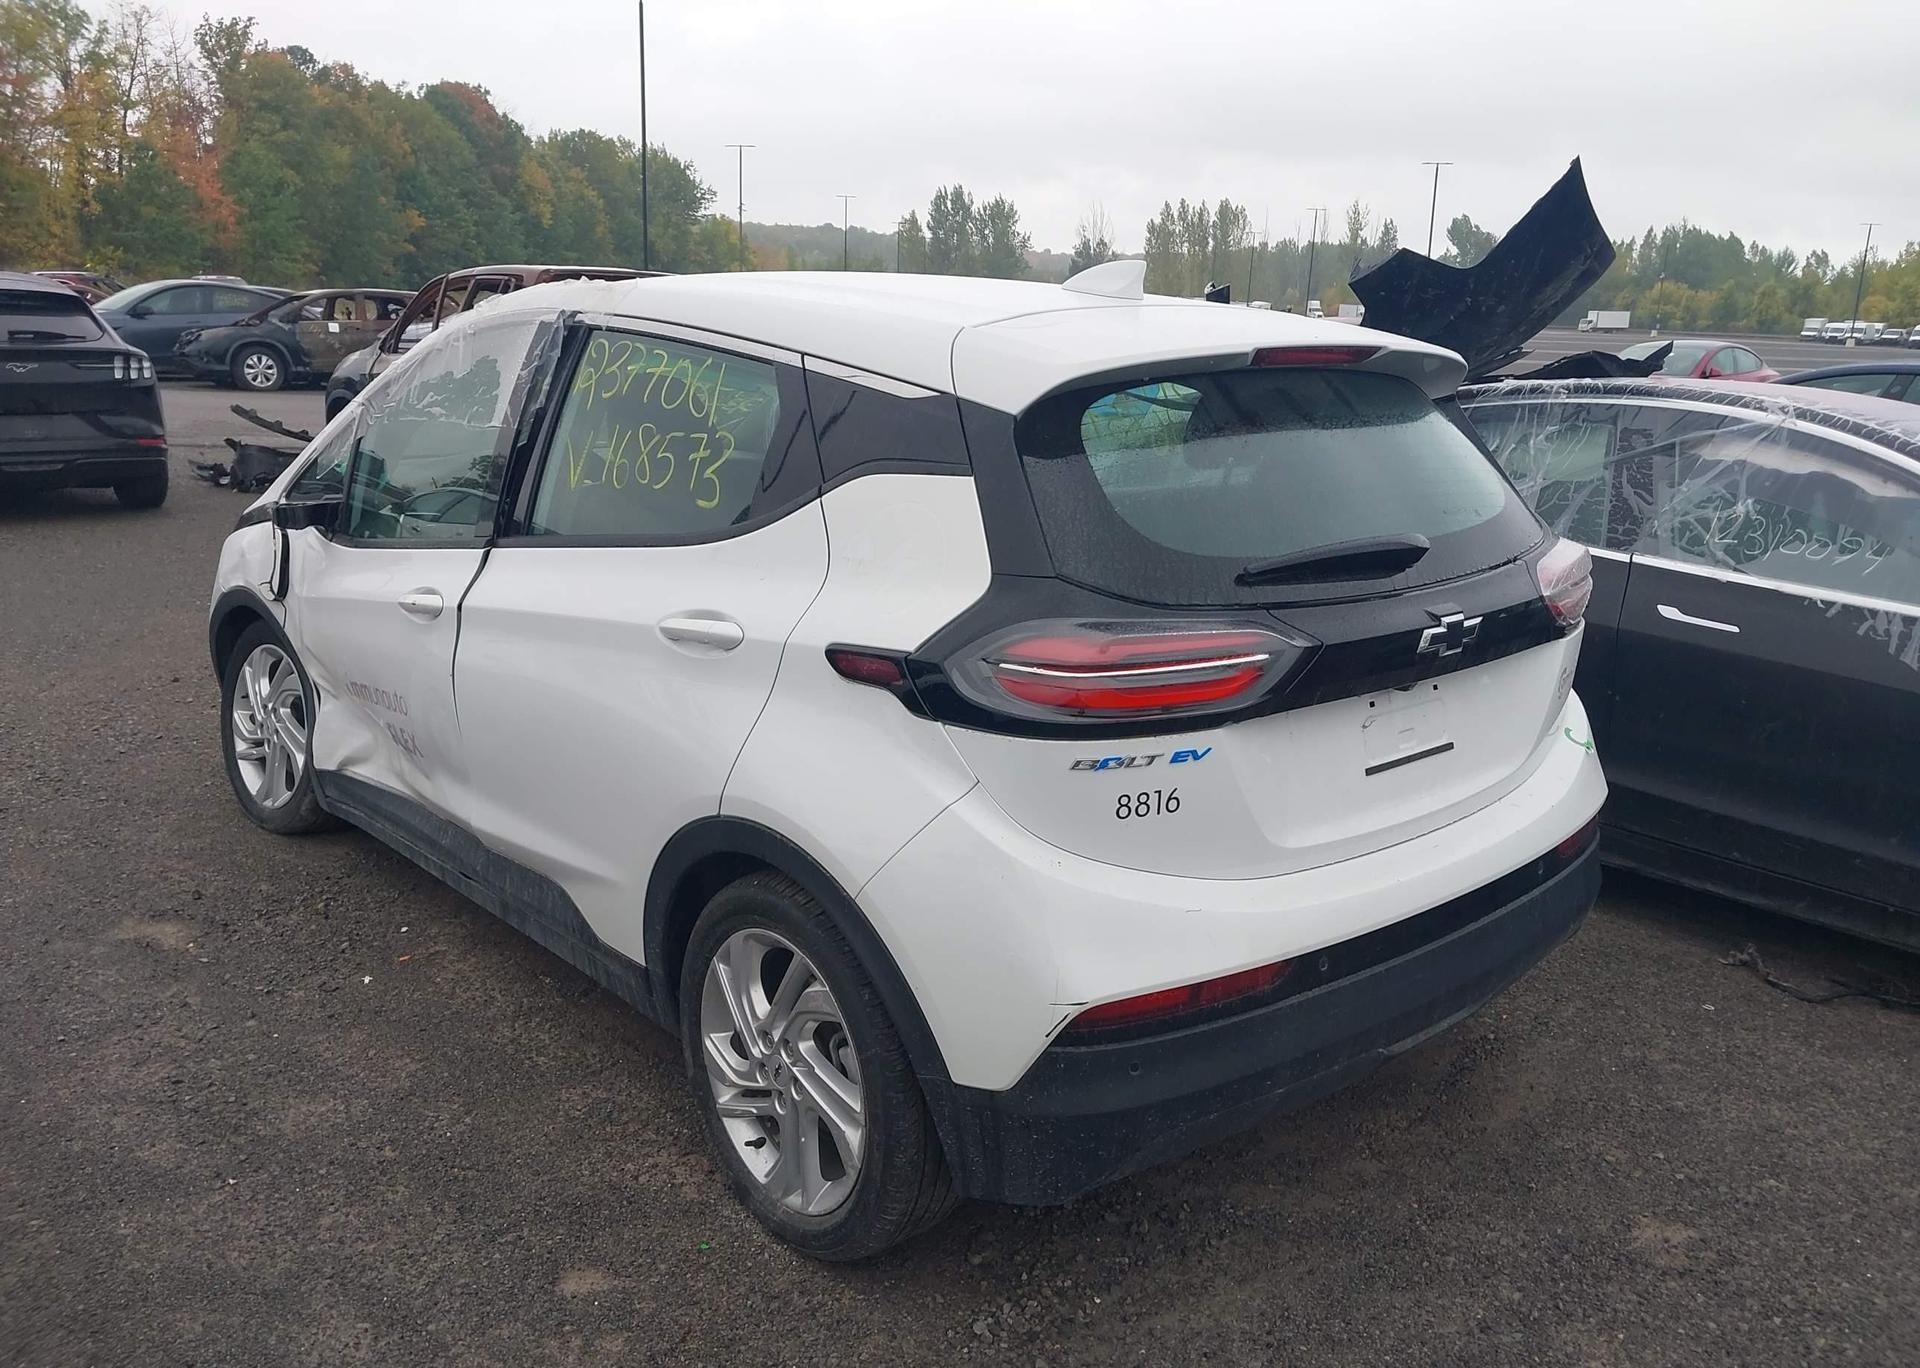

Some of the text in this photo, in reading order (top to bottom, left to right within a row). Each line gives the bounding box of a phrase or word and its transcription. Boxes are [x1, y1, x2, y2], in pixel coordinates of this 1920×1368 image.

[345, 680, 409, 717] mmunauto
[1069, 747, 1212, 772] BOLT EV
[1115, 787, 1181, 820] 8816
